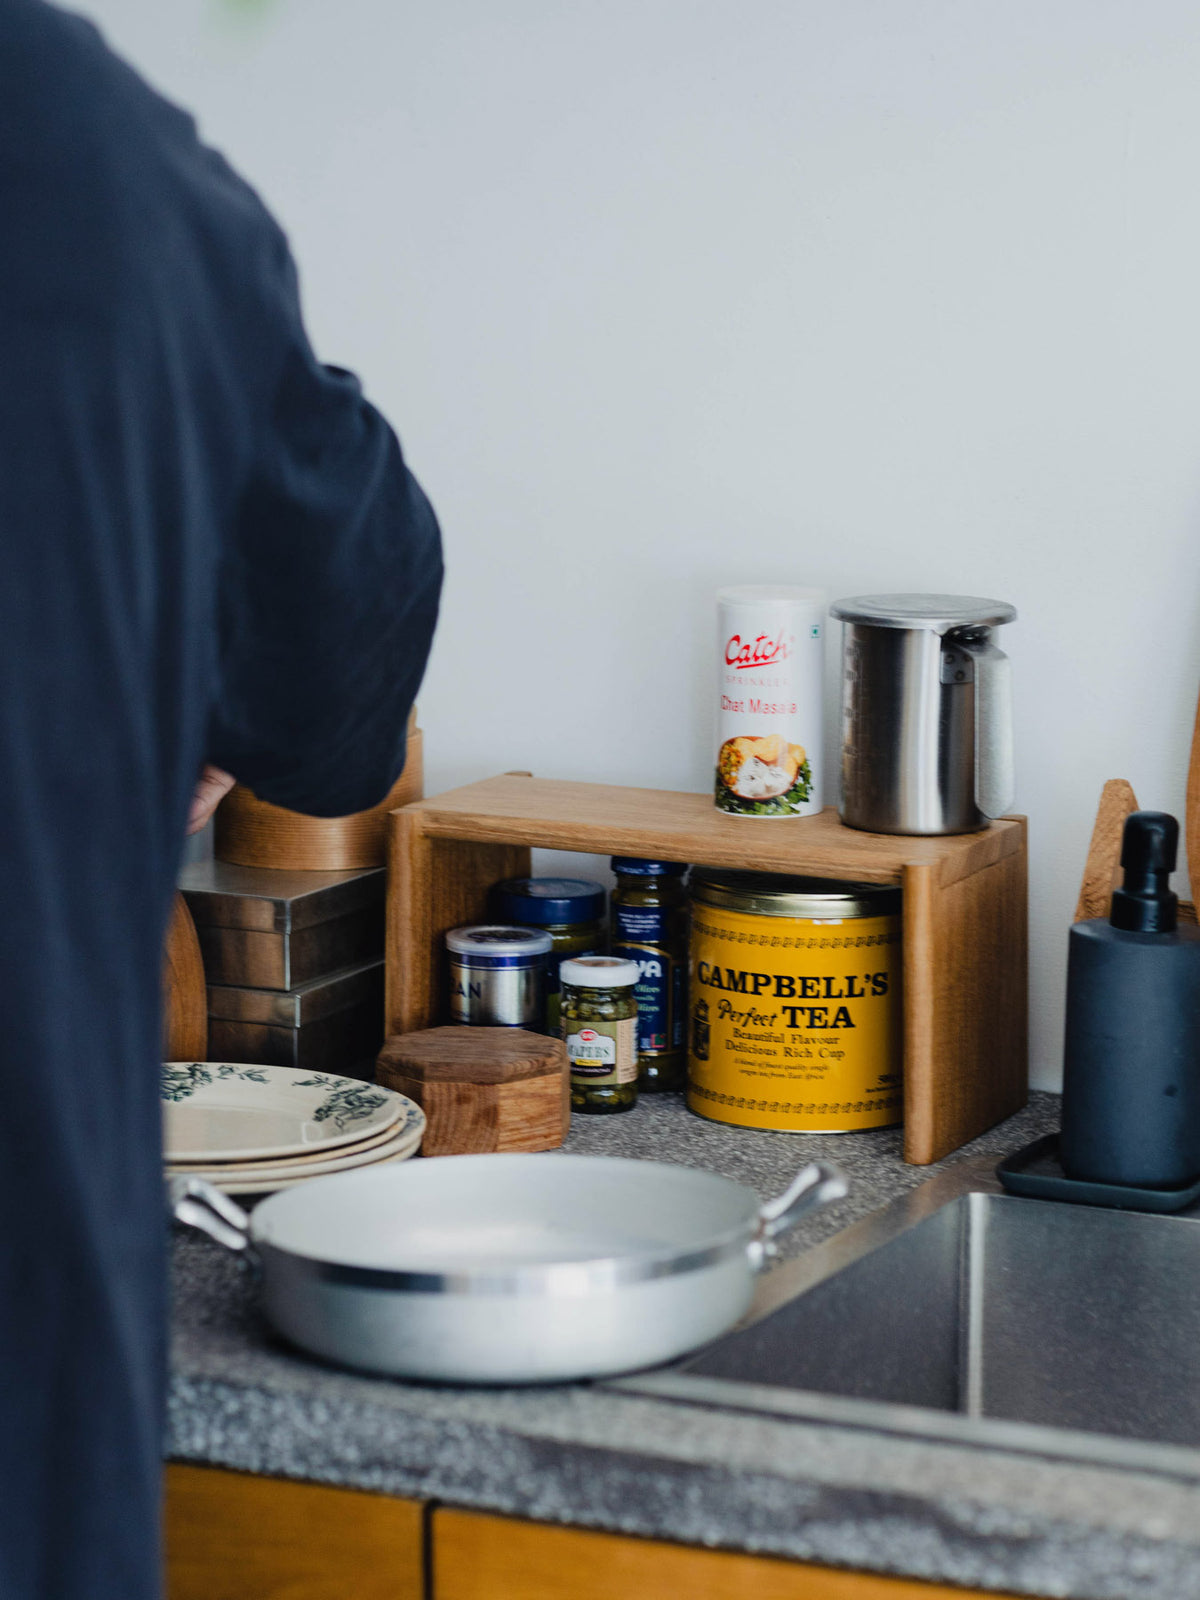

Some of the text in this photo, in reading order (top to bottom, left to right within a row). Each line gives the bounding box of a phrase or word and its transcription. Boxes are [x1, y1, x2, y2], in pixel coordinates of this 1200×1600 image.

[725, 629, 787, 667] Catch
[720, 694, 744, 712] Chat
[698, 961, 889, 999] CAMPBELL'S
[718, 999, 856, 1029] Perfect TEA
[733, 1028, 841, 1044] Beautiful Flavour
[725, 1039, 845, 1061] Delicious Rich Cup
